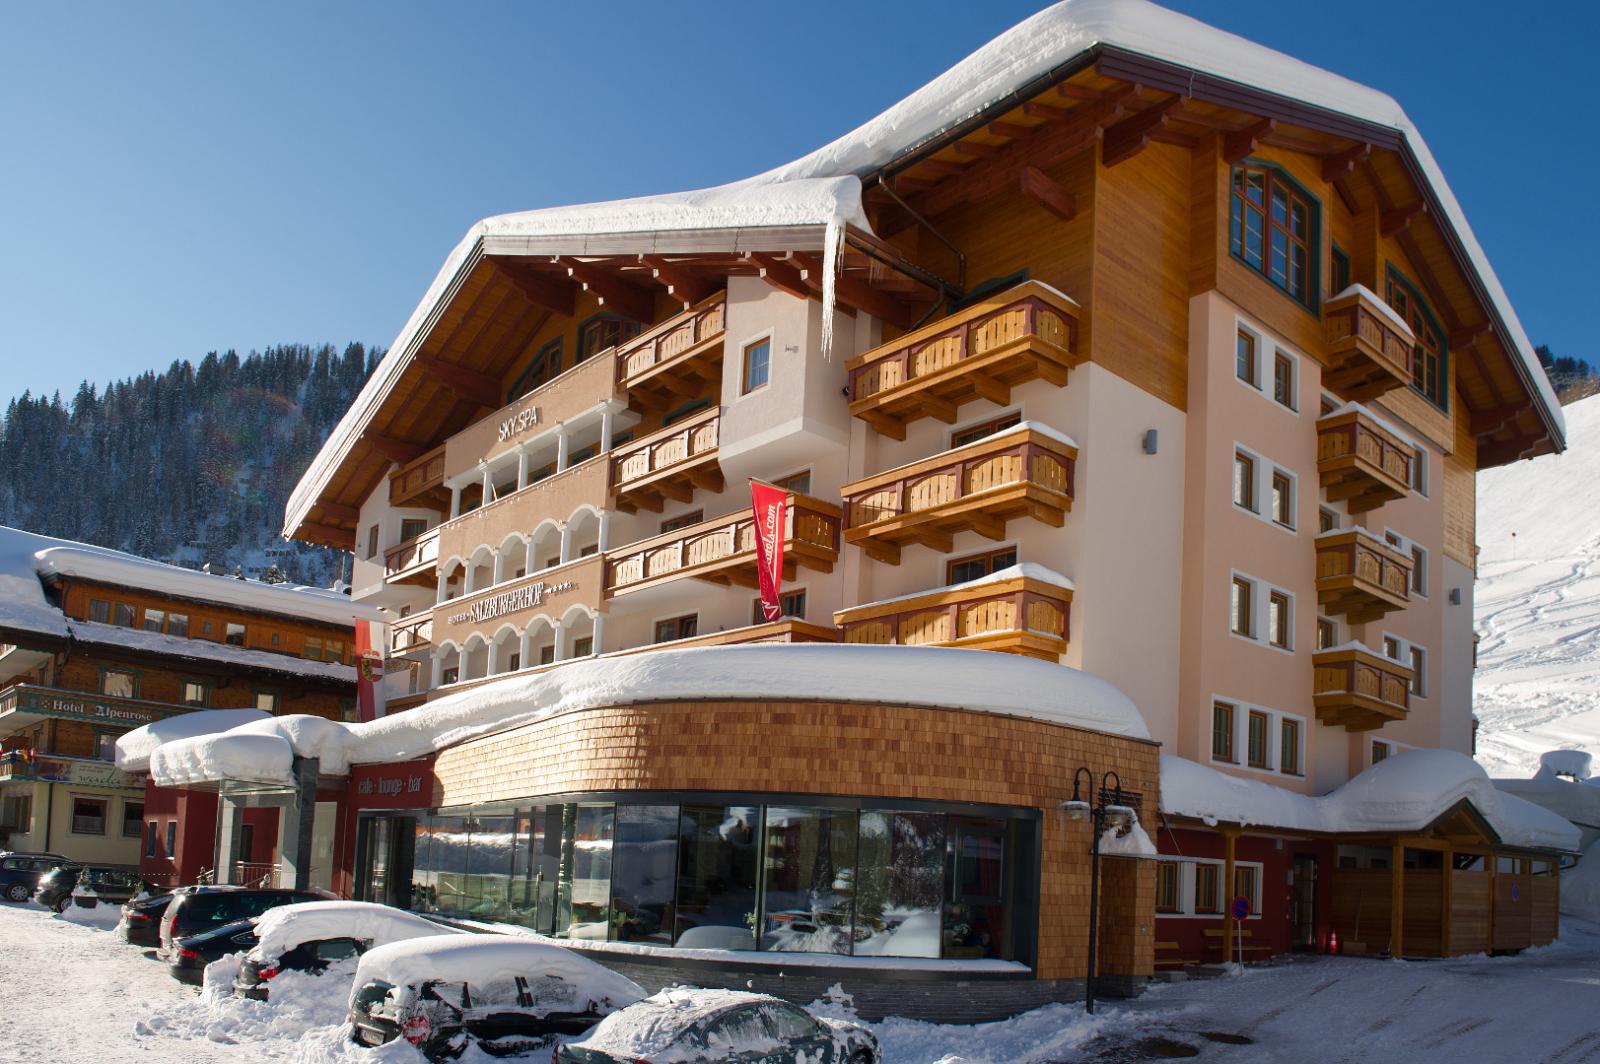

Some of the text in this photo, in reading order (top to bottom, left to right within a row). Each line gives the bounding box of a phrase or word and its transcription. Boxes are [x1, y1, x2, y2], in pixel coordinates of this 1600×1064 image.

[499, 406, 537, 442] SKY SPA
[469, 582, 544, 623] SALZBURGERHOF
[53, 700, 152, 720] Hotel Alpenrose
[378, 776, 403, 797] lounge
[408, 775, 422, 792] bar
